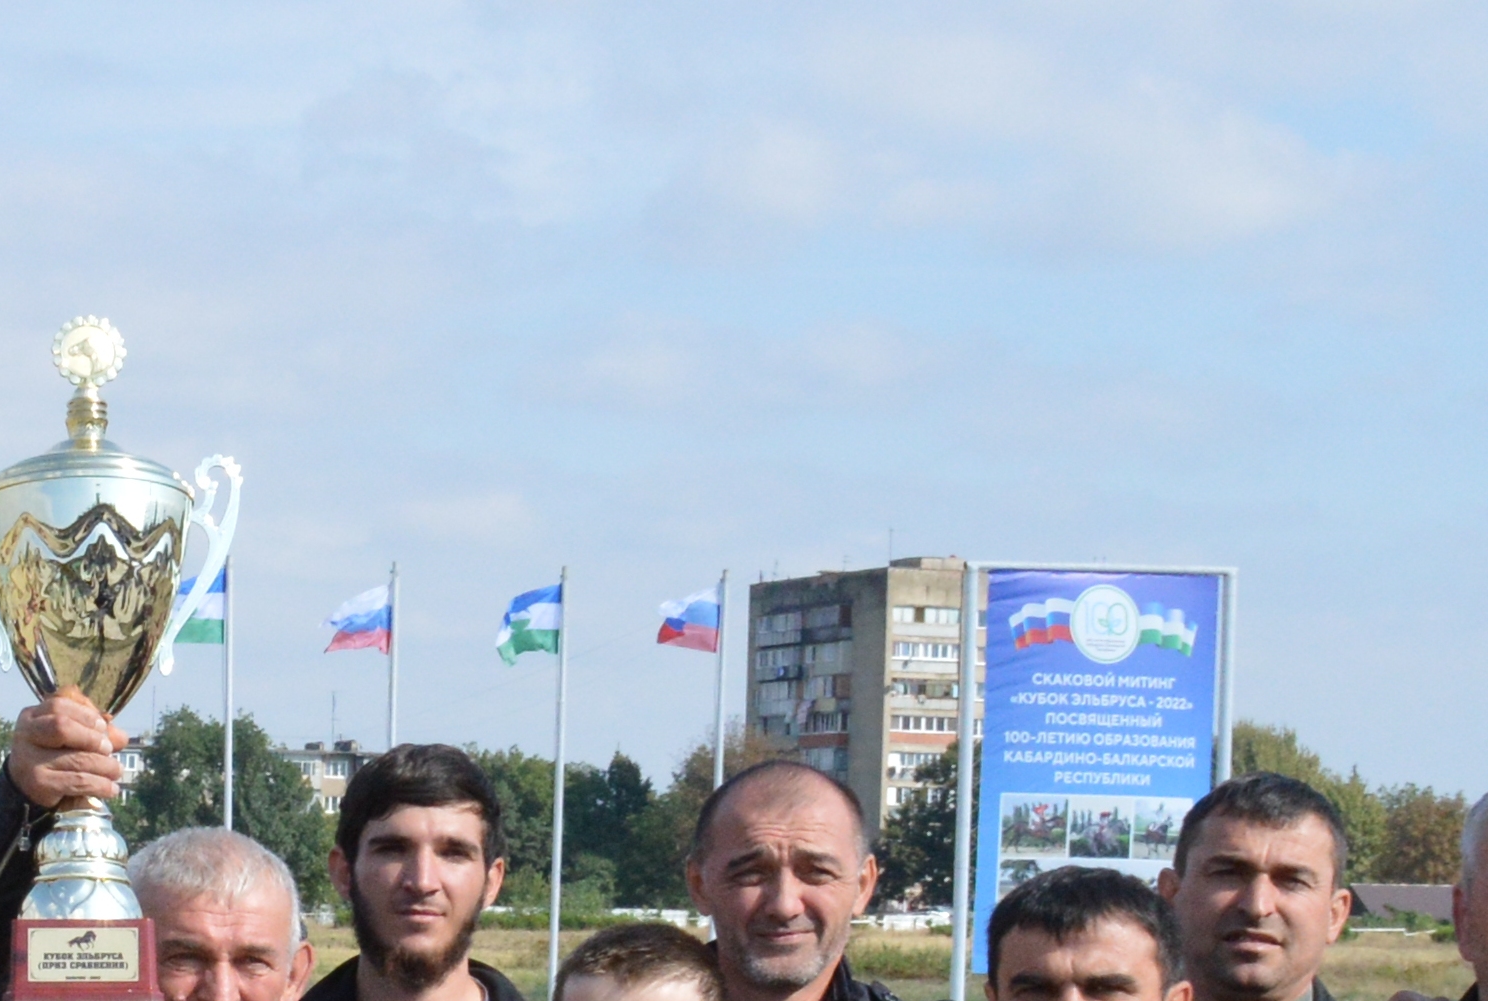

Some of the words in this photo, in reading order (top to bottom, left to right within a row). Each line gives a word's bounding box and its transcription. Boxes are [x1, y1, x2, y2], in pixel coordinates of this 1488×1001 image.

[1031, 671, 1115, 687] СКАКОВОЙ
[1117, 675, 1176, 690] МИТИНГ
[1009, 692, 1068, 706] «КУБОК
[1070, 693, 1146, 708] ЭЛЬБРУСА
[1155, 696, 1194, 710] 2022»
[1044, 711, 1164, 728] ПОСВЯЩЕННЫЙ
[1002, 730, 1091, 745] 100-ЛЕТИЮ
[1093, 733, 1197, 749] ОБРАЗОВАНИЯ
[1002, 750, 1195, 768] КАБАРДИНО-БАЛКАРСКОЙ
[1053, 771, 1152, 786] РЕСПУБЛИКИ
[43, 952, 74, 960] КУБОК
[76, 952, 124, 960] ЭЛЬБРУСА
